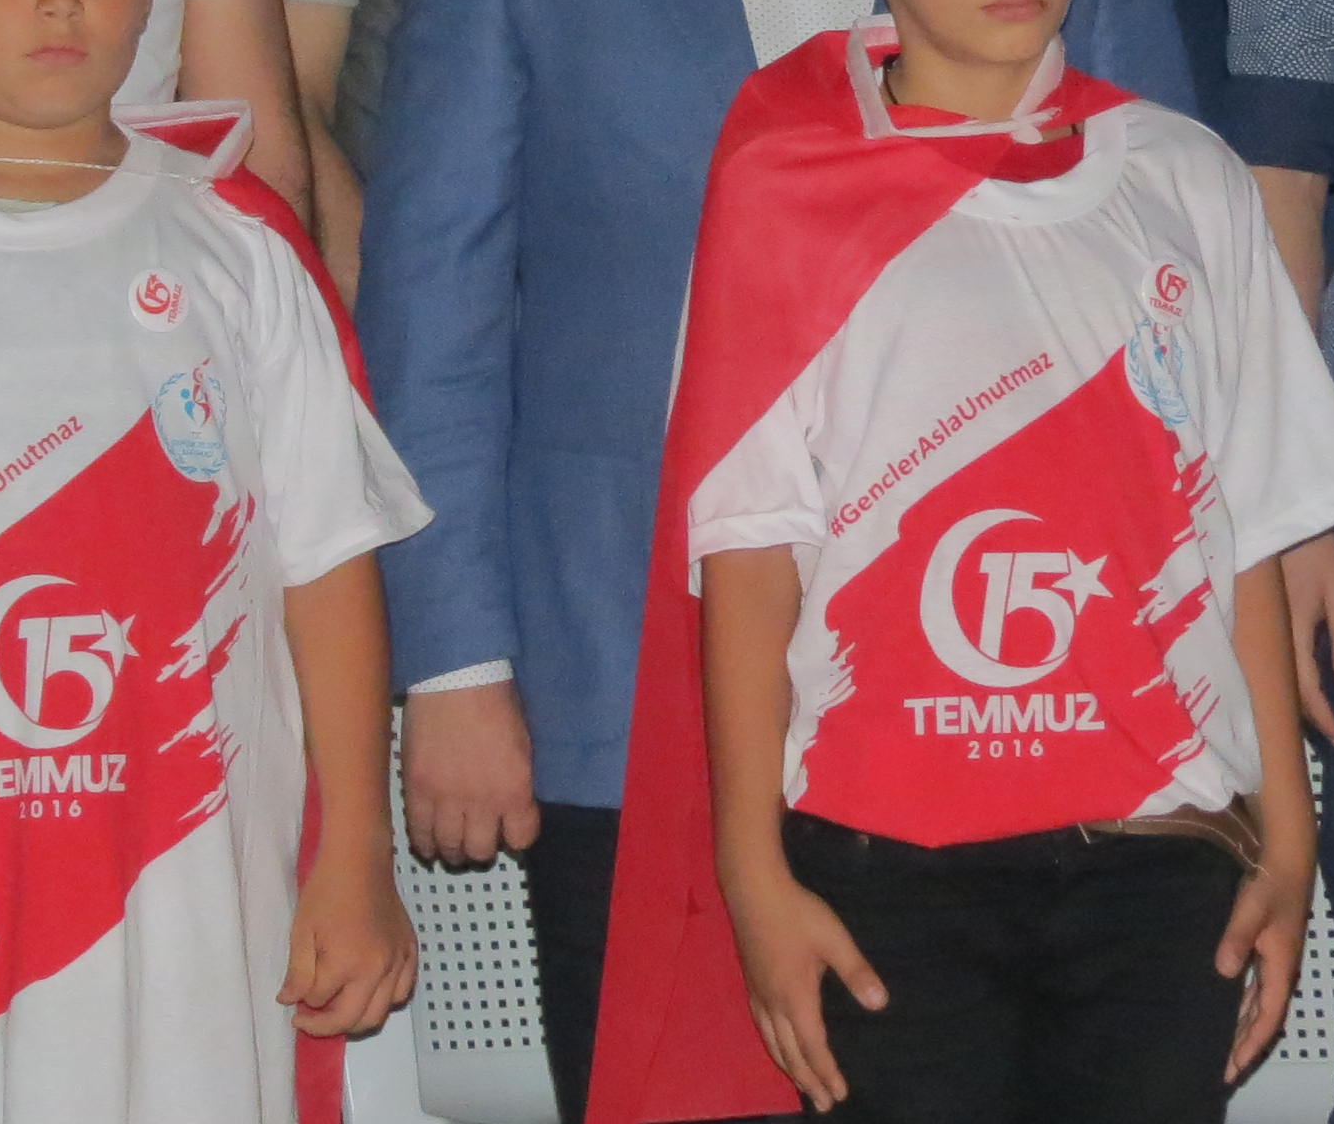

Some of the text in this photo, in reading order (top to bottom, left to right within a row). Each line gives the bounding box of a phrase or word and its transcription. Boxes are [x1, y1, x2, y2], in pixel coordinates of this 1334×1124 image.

[830, 351, 1055, 538] #GenclerAslaUnutmaz
[979, 551, 1077, 666] 15
[18, 614, 117, 729] 15
[903, 692, 1105, 735] TEMMUZ
[967, 737, 1045, 760] 2016
[18, 799, 83, 820] 2016
